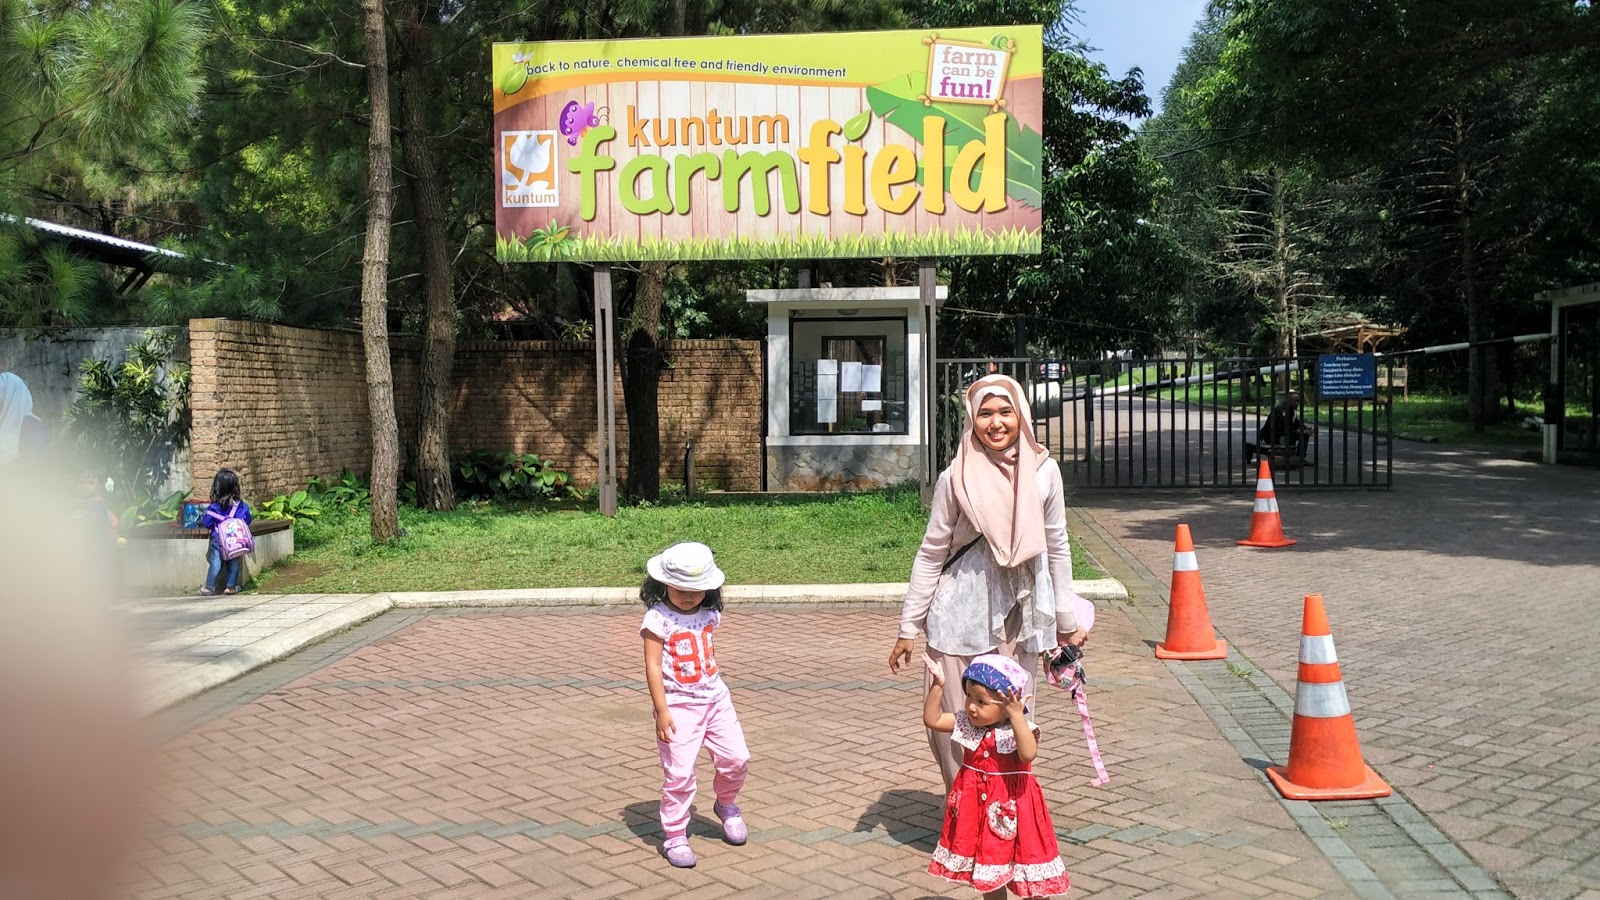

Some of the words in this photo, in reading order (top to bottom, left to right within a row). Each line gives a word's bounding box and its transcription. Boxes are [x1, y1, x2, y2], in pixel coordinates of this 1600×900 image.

[942, 46, 997, 66] farm
[526, 62, 556, 75] back
[559, 61, 570, 71] to
[573, 58, 613, 69] nature,
[616, 57, 671, 68] chemical
[674, 57, 697, 69] free
[700, 59, 723, 70] and
[726, 60, 769, 75] friendly
[772, 64, 847, 78] environment
[941, 66, 970, 77] can
[975, 65, 995, 78] be
[939, 76, 992, 99] fun!
[626, 105, 789, 147] kuntum
[505, 190, 556, 204] kuntum
